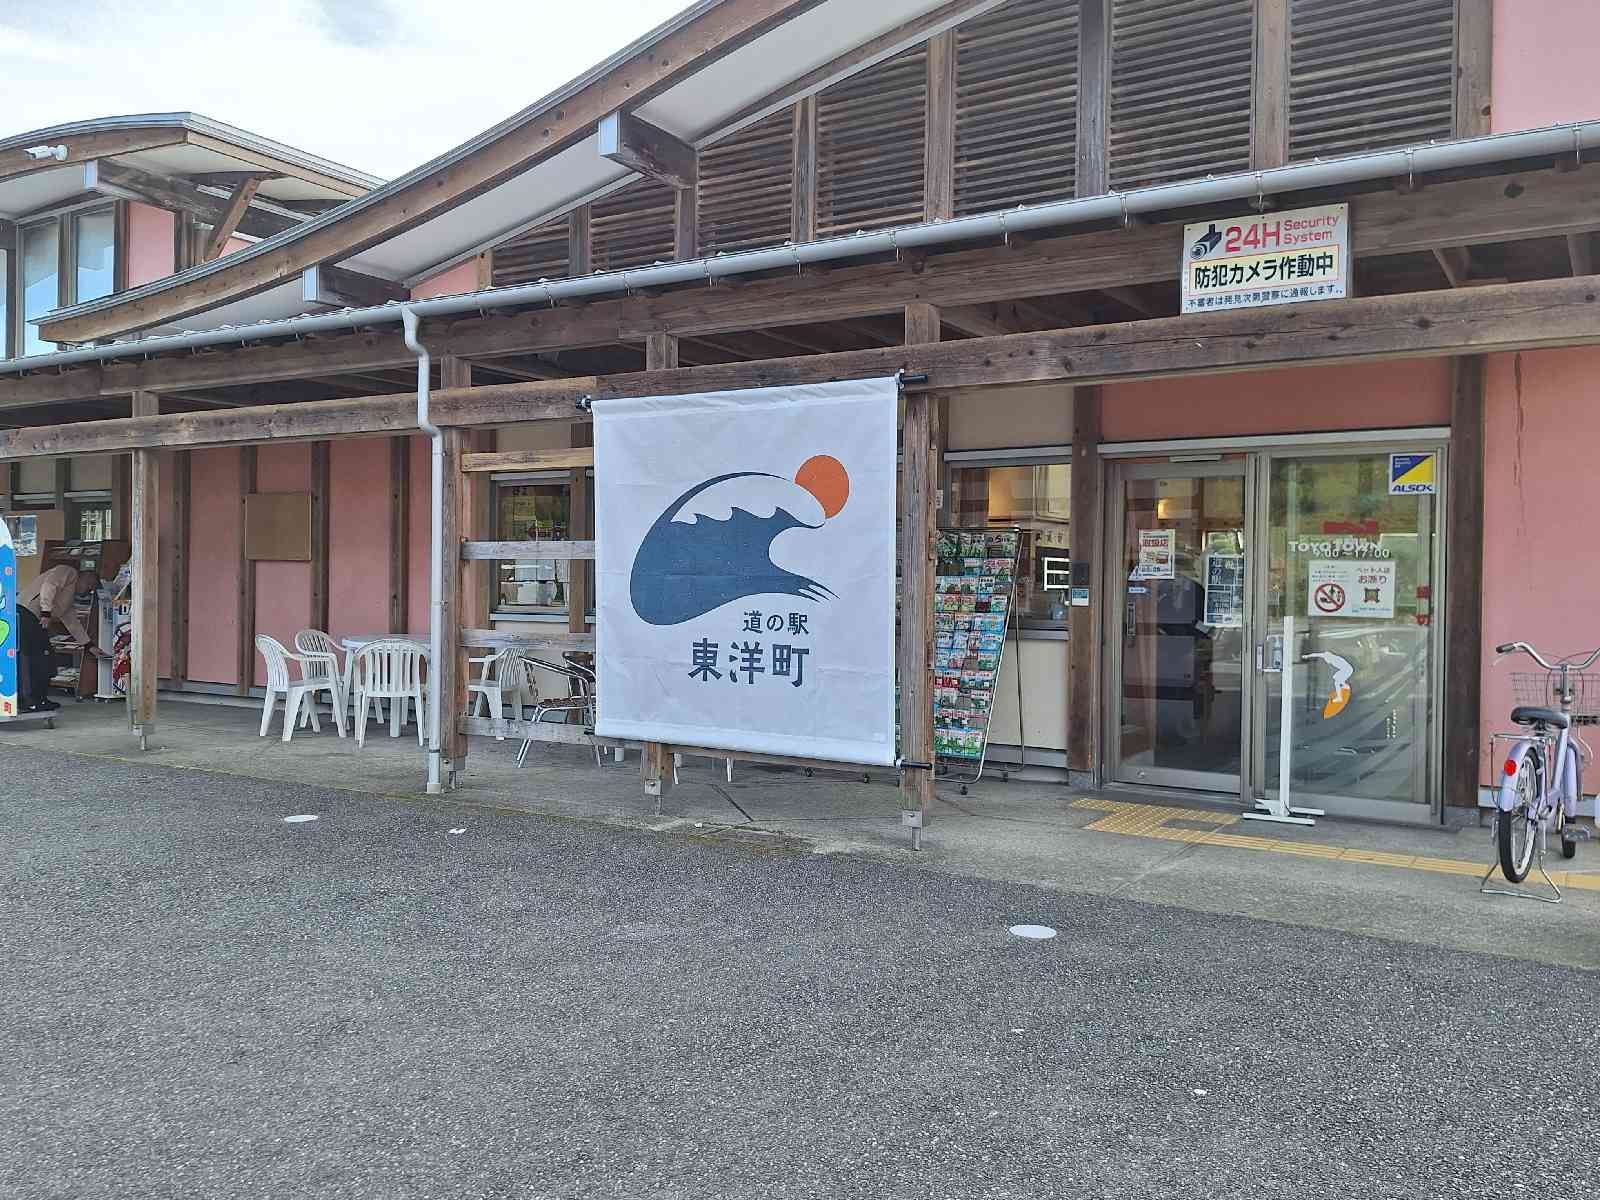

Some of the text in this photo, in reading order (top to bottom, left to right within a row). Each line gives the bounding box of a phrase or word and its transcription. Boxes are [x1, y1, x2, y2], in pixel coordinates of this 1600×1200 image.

[1225, 215, 1339, 252] 24H Security
[1284, 230, 1332, 246] System
[1194, 251, 1334, 289] 防犯カメラ作動中
[1392, 484, 1432, 493] ALSOK
[742, 610, 809, 636] 道の駅
[688, 637, 810, 688] 東洋町
